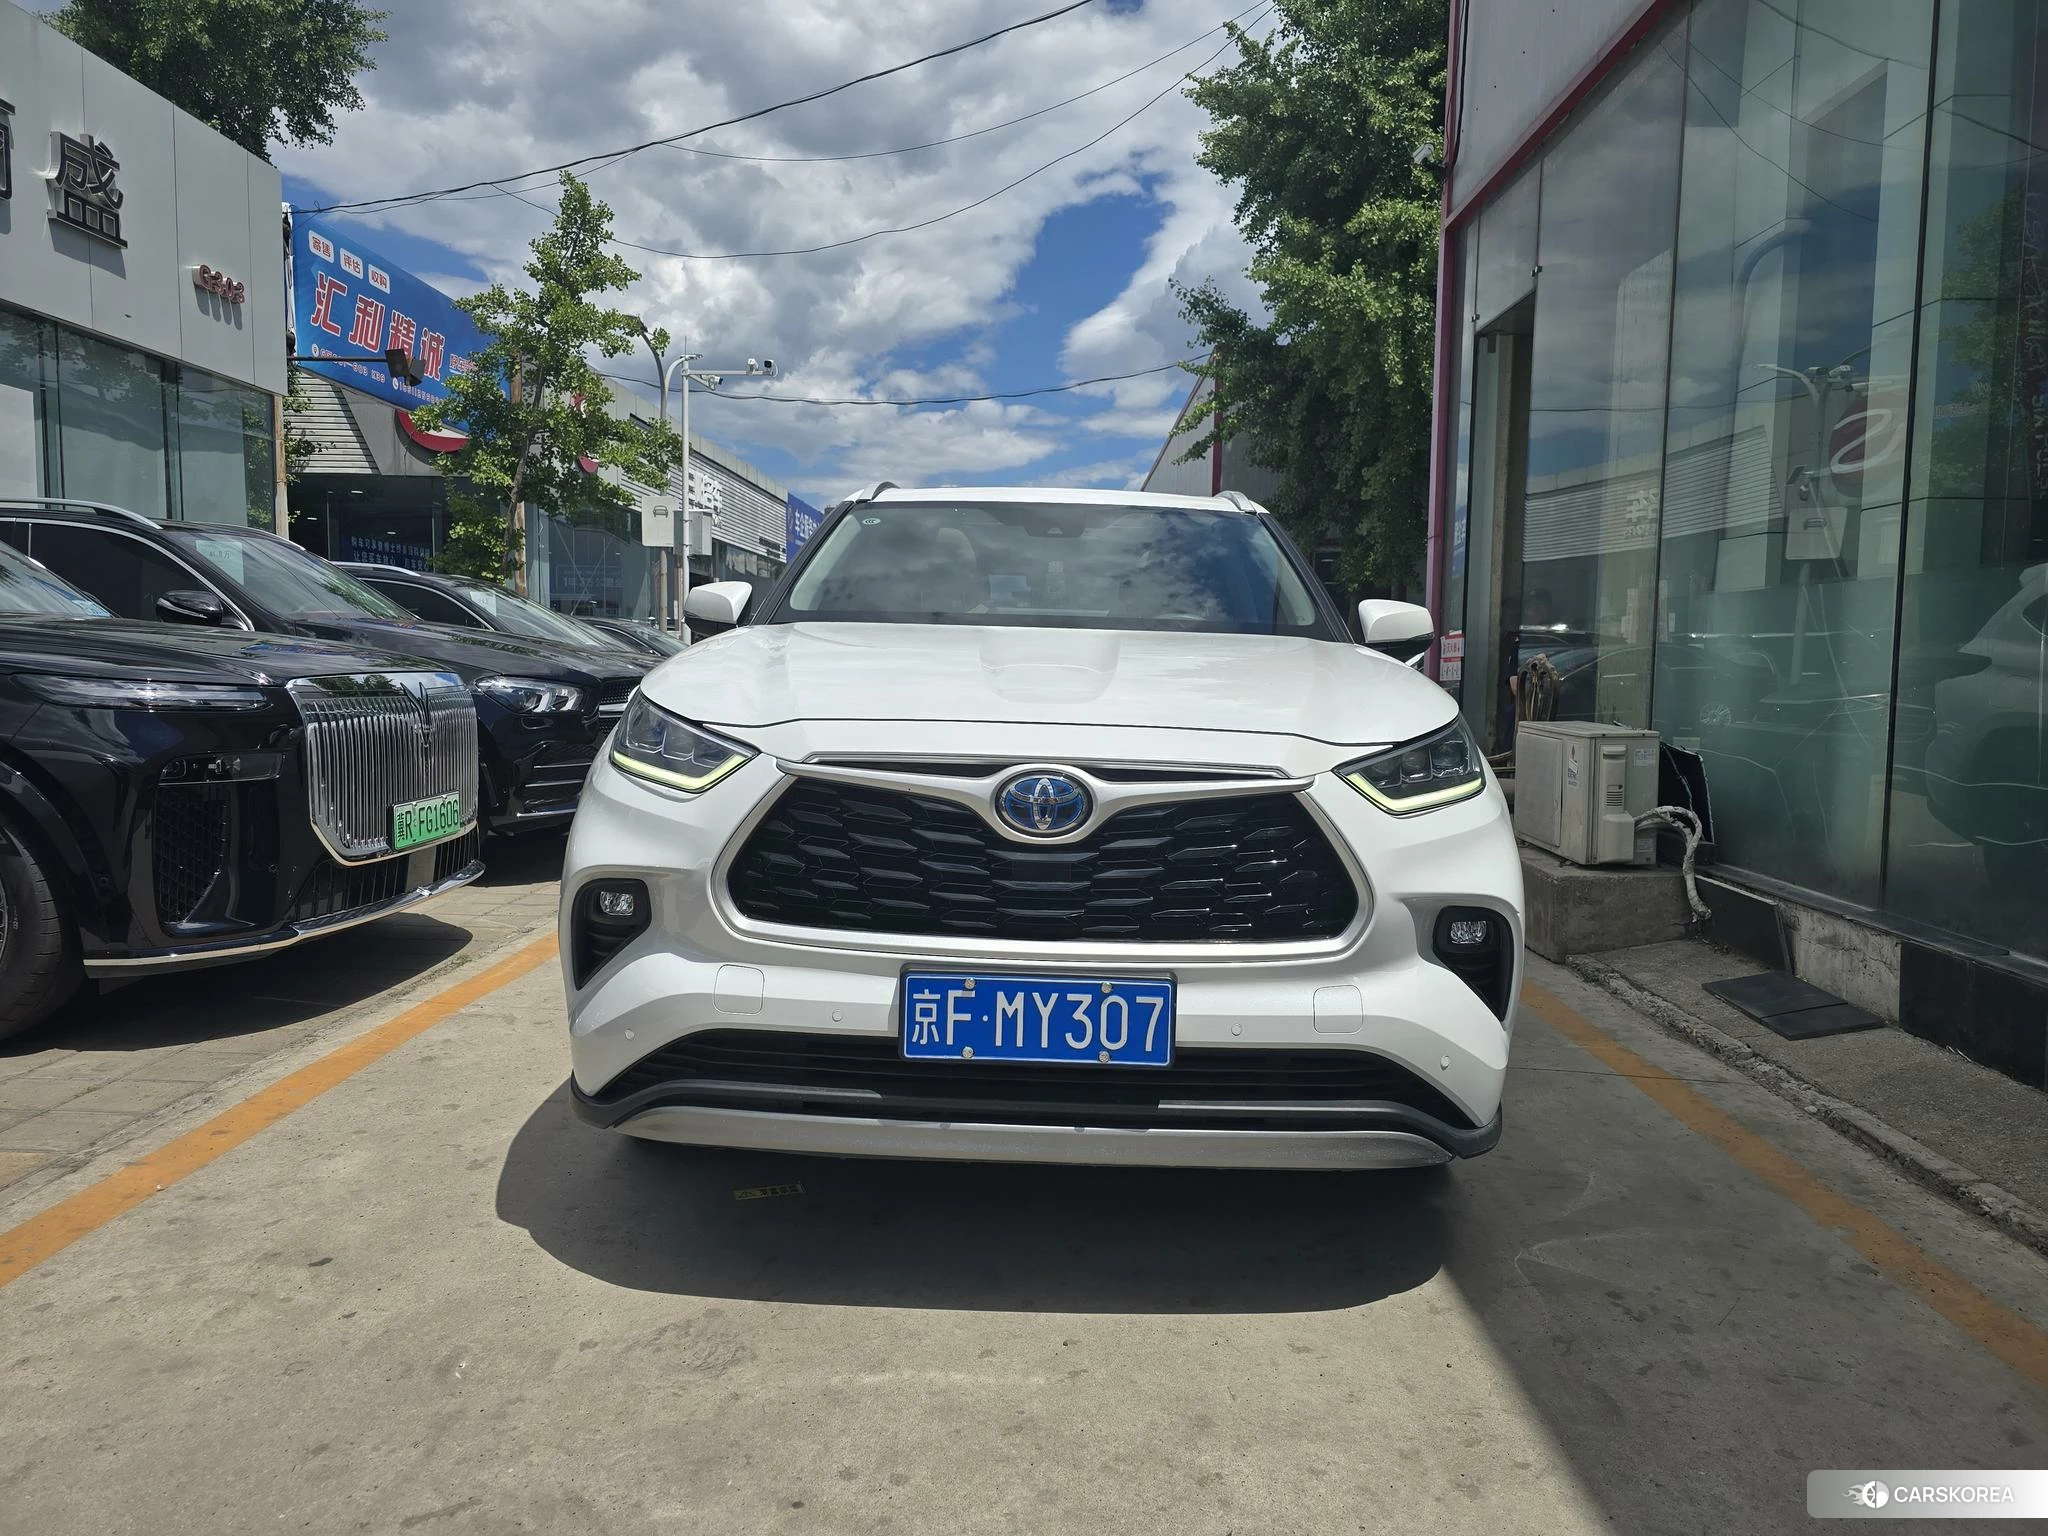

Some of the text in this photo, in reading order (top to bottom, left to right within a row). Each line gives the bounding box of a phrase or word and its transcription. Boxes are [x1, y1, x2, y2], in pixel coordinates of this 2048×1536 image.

[195, 264, 245, 304] G303
[310, 270, 446, 381] 汇利精诚
